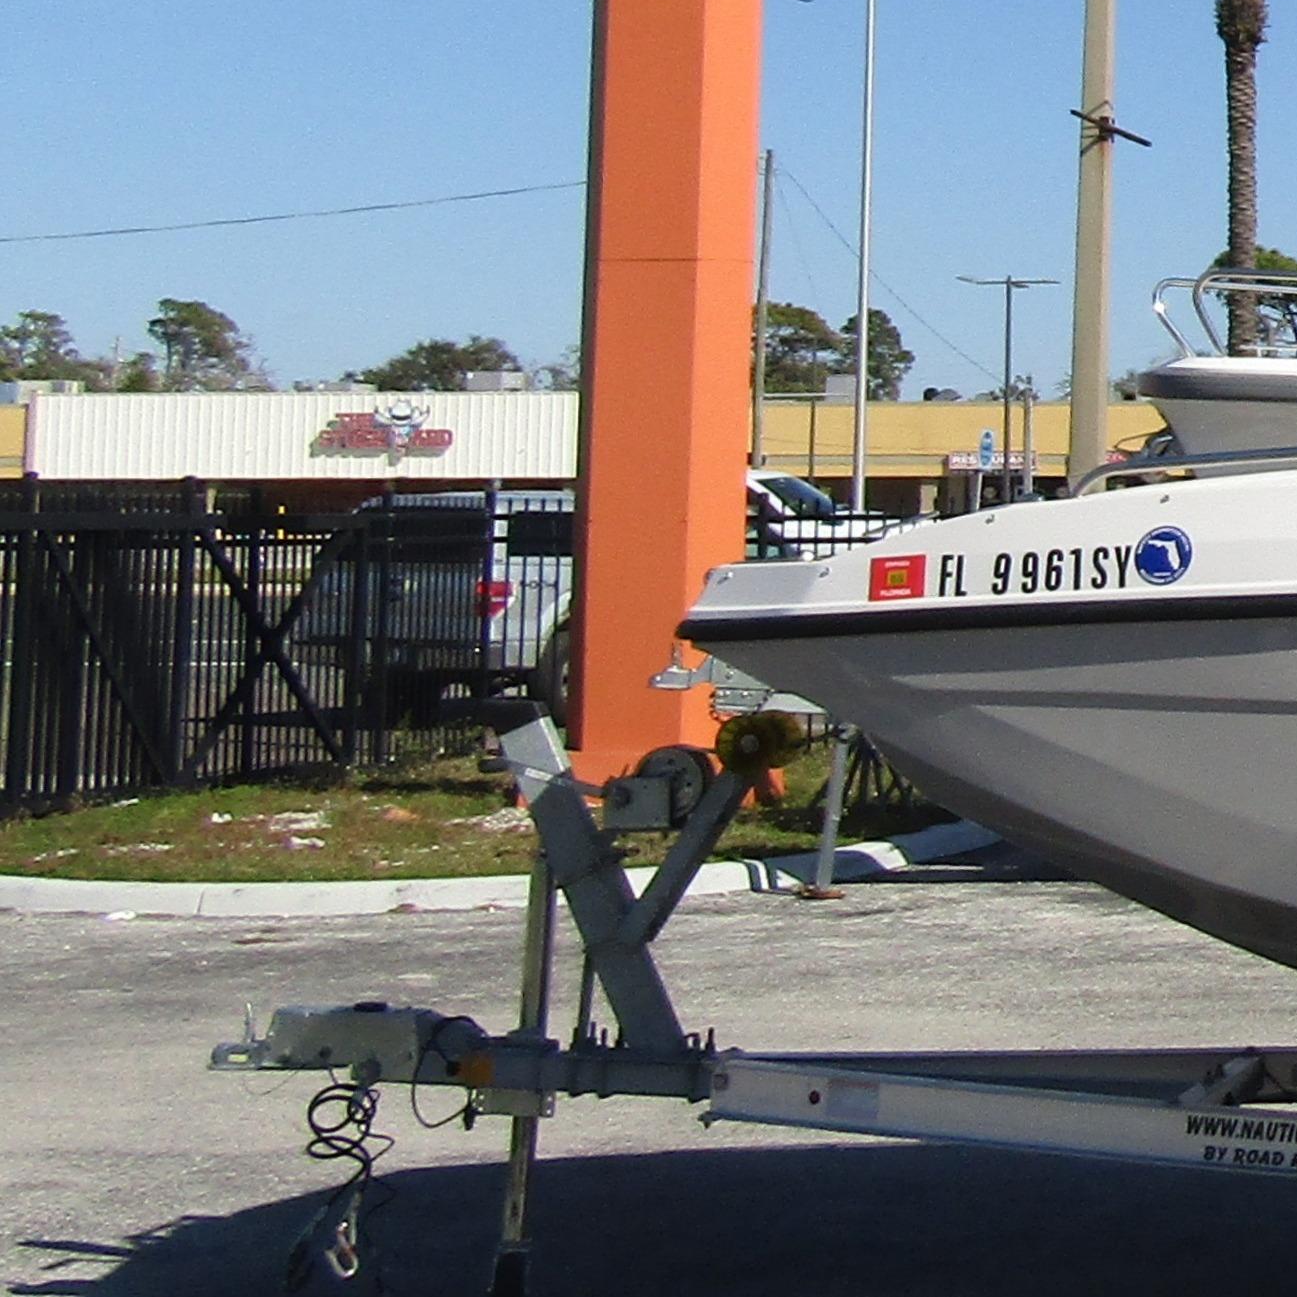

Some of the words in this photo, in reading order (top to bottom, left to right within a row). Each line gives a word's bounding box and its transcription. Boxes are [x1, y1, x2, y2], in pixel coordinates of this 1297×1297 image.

[937, 554, 968, 598] FL
[1203, 1145, 1227, 1162] BY
[1232, 1147, 1285, 1167] ROAD
